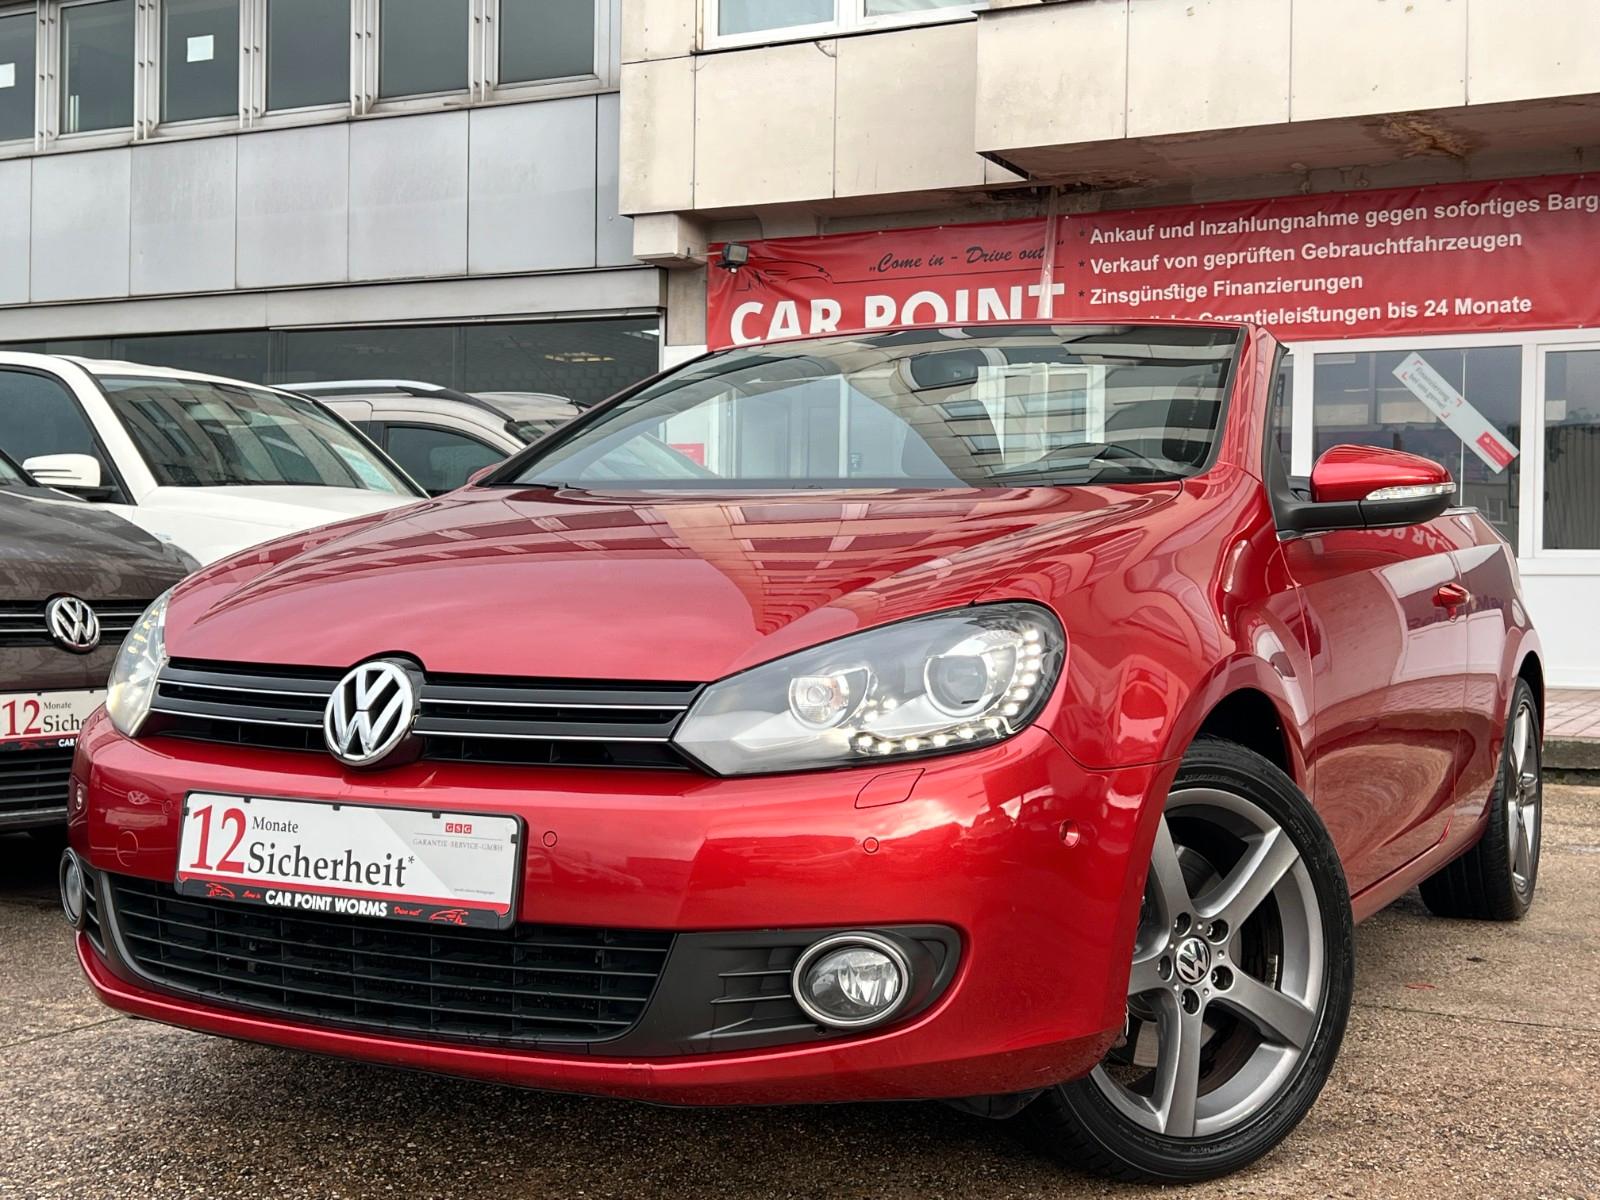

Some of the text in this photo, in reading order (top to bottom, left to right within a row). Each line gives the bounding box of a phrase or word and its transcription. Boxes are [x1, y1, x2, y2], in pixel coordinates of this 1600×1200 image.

[1090, 193, 1599, 245] Ankauf und Inzahlungnahme gegen sofortiges Barg
[928, 254, 945, 267] in
[966, 246, 1013, 264] Drive
[1090, 232, 1522, 275] Verkauf von geprüften Gebrauchtfahrzeugen
[1090, 274, 1363, 307] Zinsgünstige Finanzierungen
[1388, 301, 1418, 319] bis
[1423, 299, 1448, 317] 24
[1454, 296, 1532, 316] Monate
[730, 283, 1065, 346] CAR POINT
[2, 700, 72, 736] 12 Monate
[324, 661, 413, 761] VW
[58, 738, 75, 748] CAR
[189, 803, 299, 875] 12 Monate
[446, 823, 472, 834] GSG
[265, 890, 291, 907] CAR
[294, 894, 332, 912] POINT
[334, 898, 388, 918] WORMS
